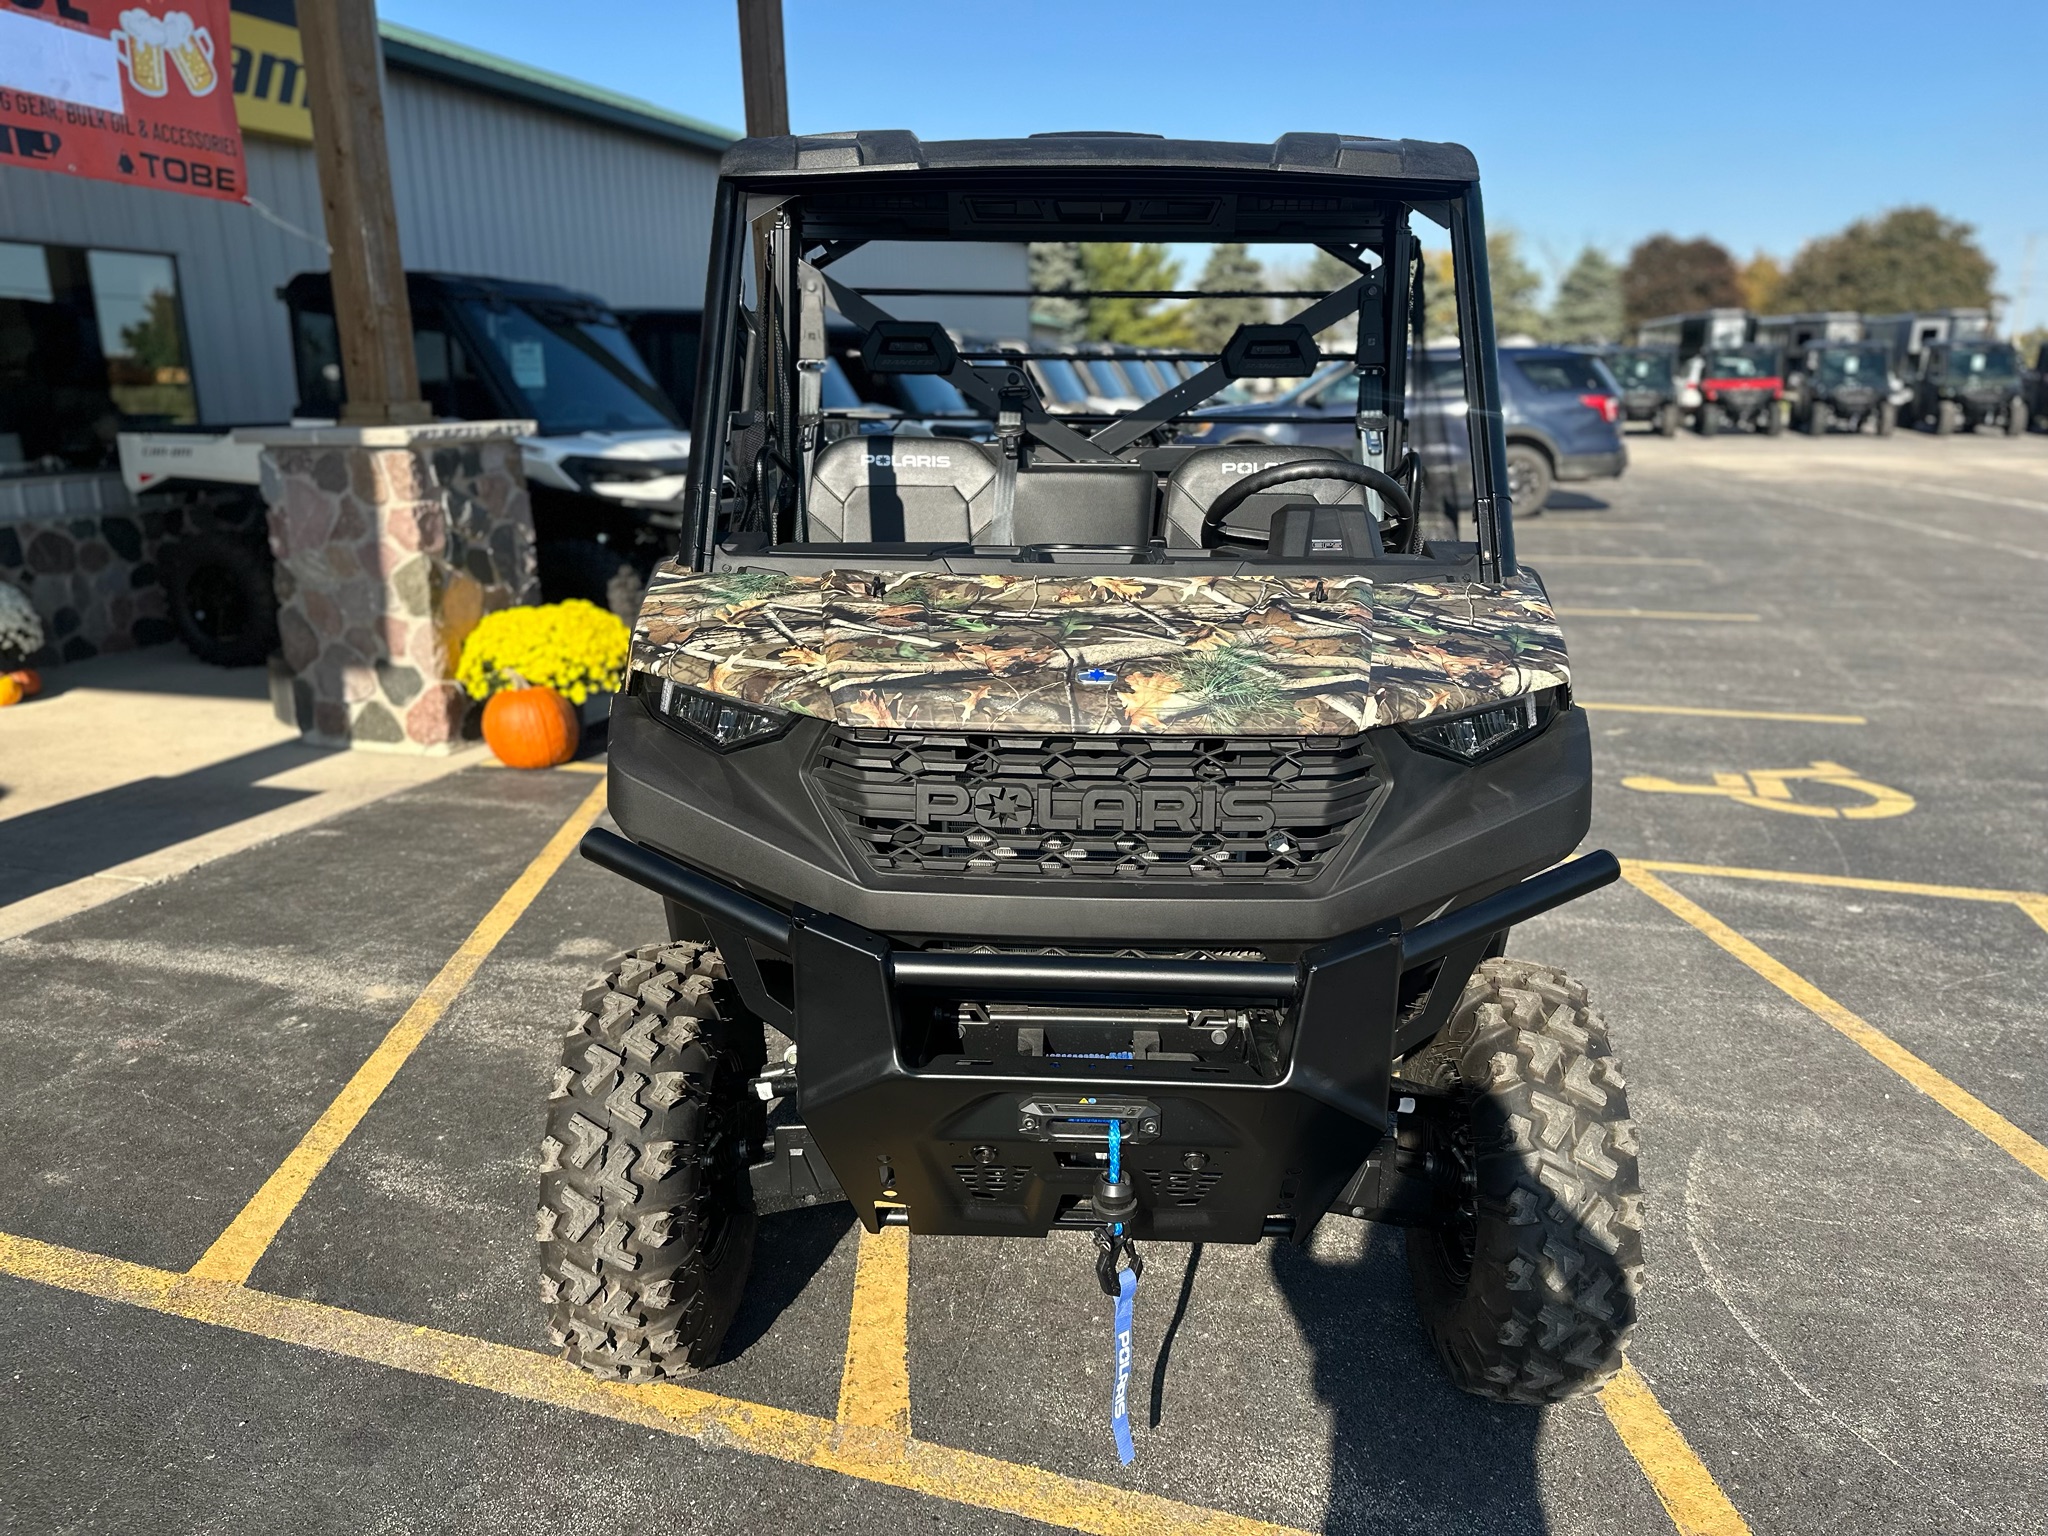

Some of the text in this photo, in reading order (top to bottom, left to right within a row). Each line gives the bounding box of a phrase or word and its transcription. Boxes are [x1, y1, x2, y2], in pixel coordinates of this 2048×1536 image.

[65, 102, 107, 130] BULK
[111, 113, 135, 136] OIL
[139, 118, 148, 138] &
[153, 122, 238, 157] ACCESSORIES
[139, 151, 235, 192] TOBE
[860, 454, 951, 468] POLARIS
[915, 779, 1276, 832] POLARIS
[1114, 1330, 1130, 1420] POLARIS
